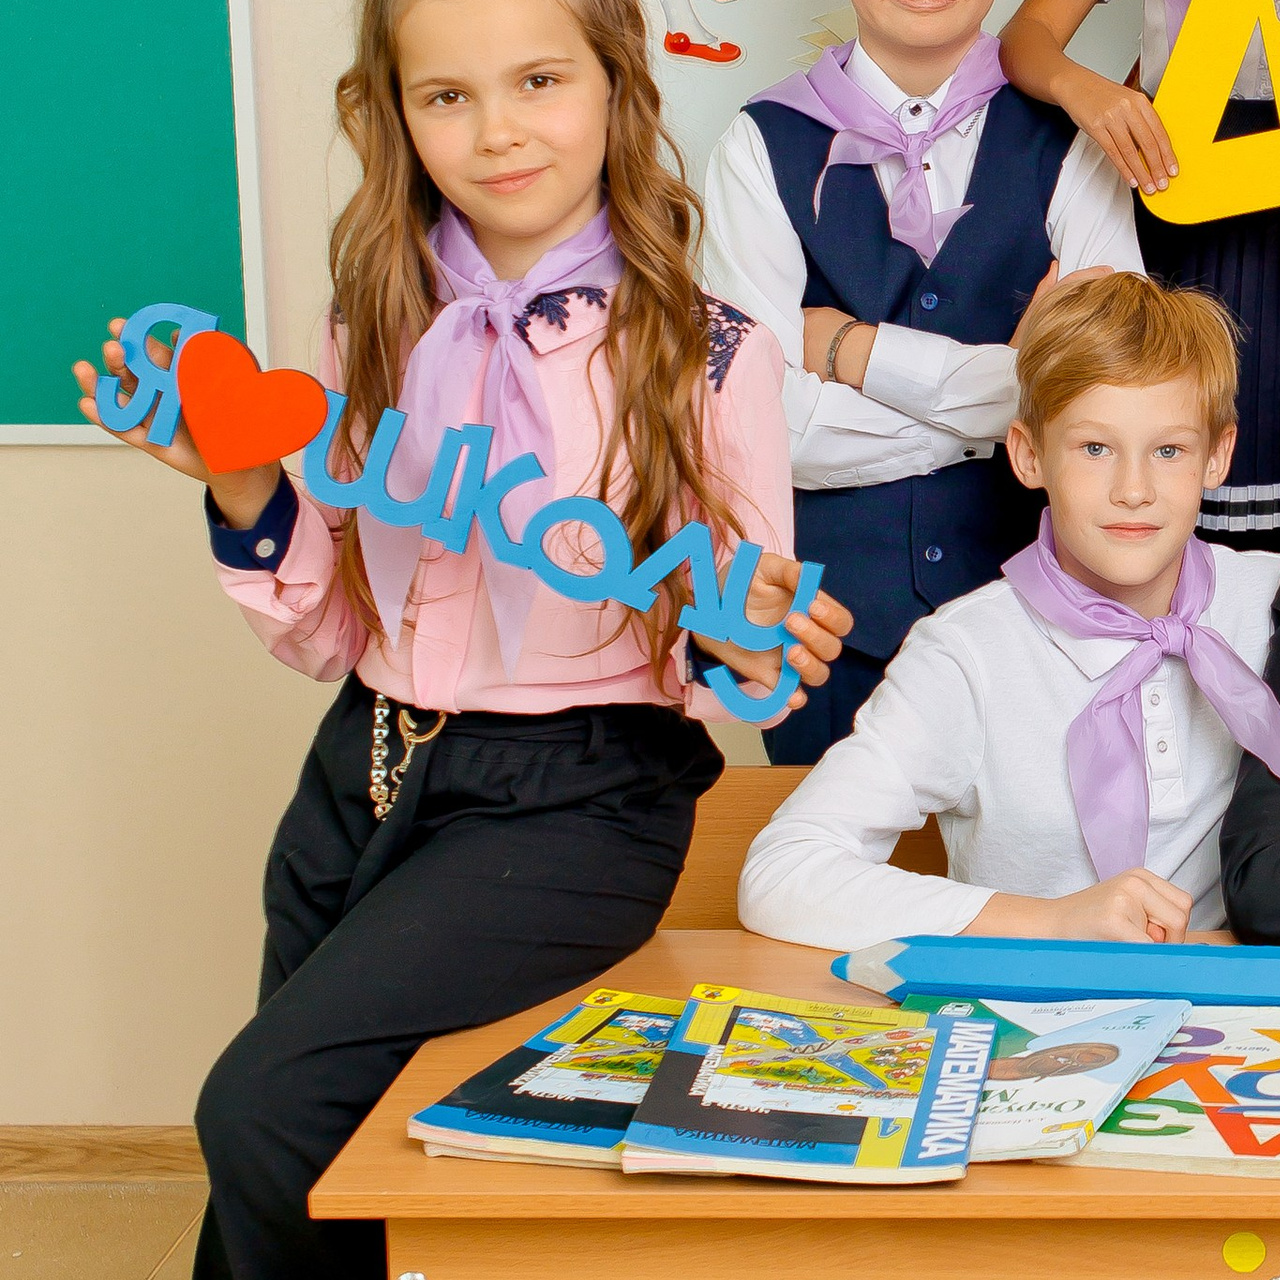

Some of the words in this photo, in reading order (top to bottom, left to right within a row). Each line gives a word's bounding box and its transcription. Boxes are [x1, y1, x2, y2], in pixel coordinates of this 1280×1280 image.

[96, 303, 221, 447] Я
[464, 1109, 594, 1134] МАТЕМАТИКА
[918, 1022, 998, 1160] МАТЕМАТИКА
[673, 1127, 818, 1151] МАТЕМАТИКА
